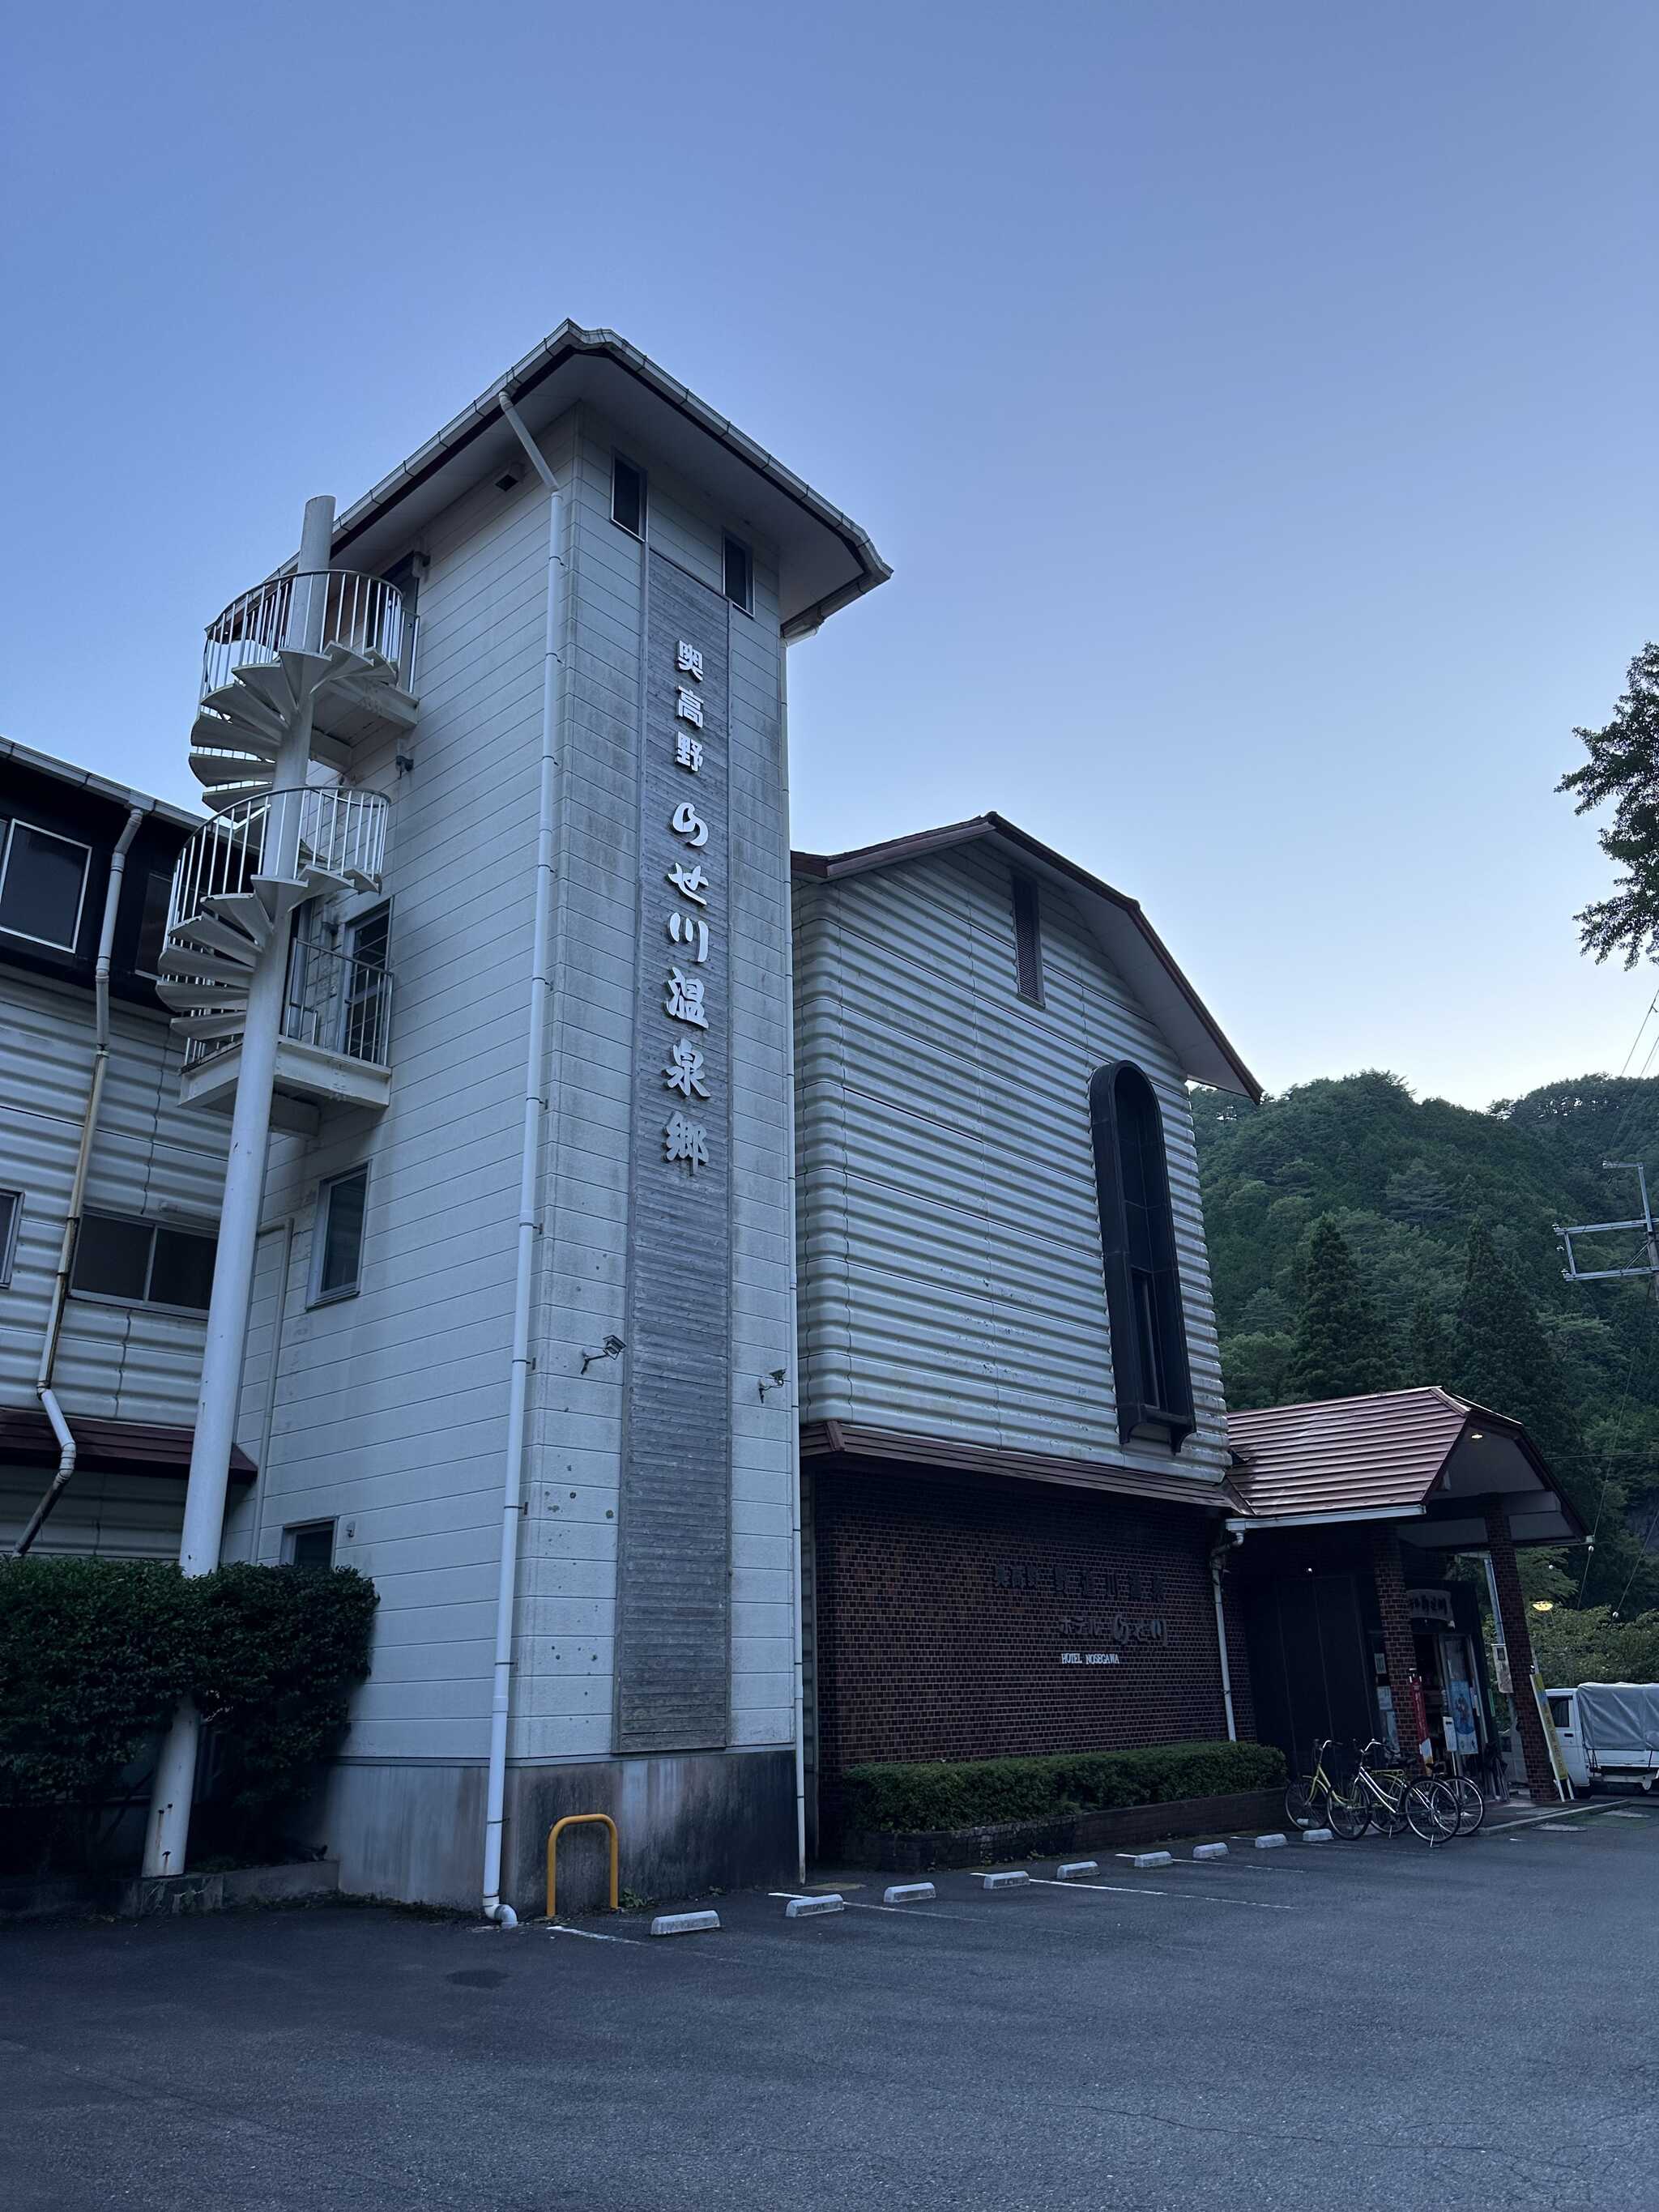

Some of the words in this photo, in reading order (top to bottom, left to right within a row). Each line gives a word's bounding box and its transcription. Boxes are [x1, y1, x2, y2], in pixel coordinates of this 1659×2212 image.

[676, 640, 703, 773] 奥高野
[664, 802, 712, 1176] のせ川温泉郷
[1059, 1615, 1102, 1636] ホテル
[1061, 1652, 1082, 1664] HOTEL
[1085, 1653, 1120, 1665] NOSEGAWA
